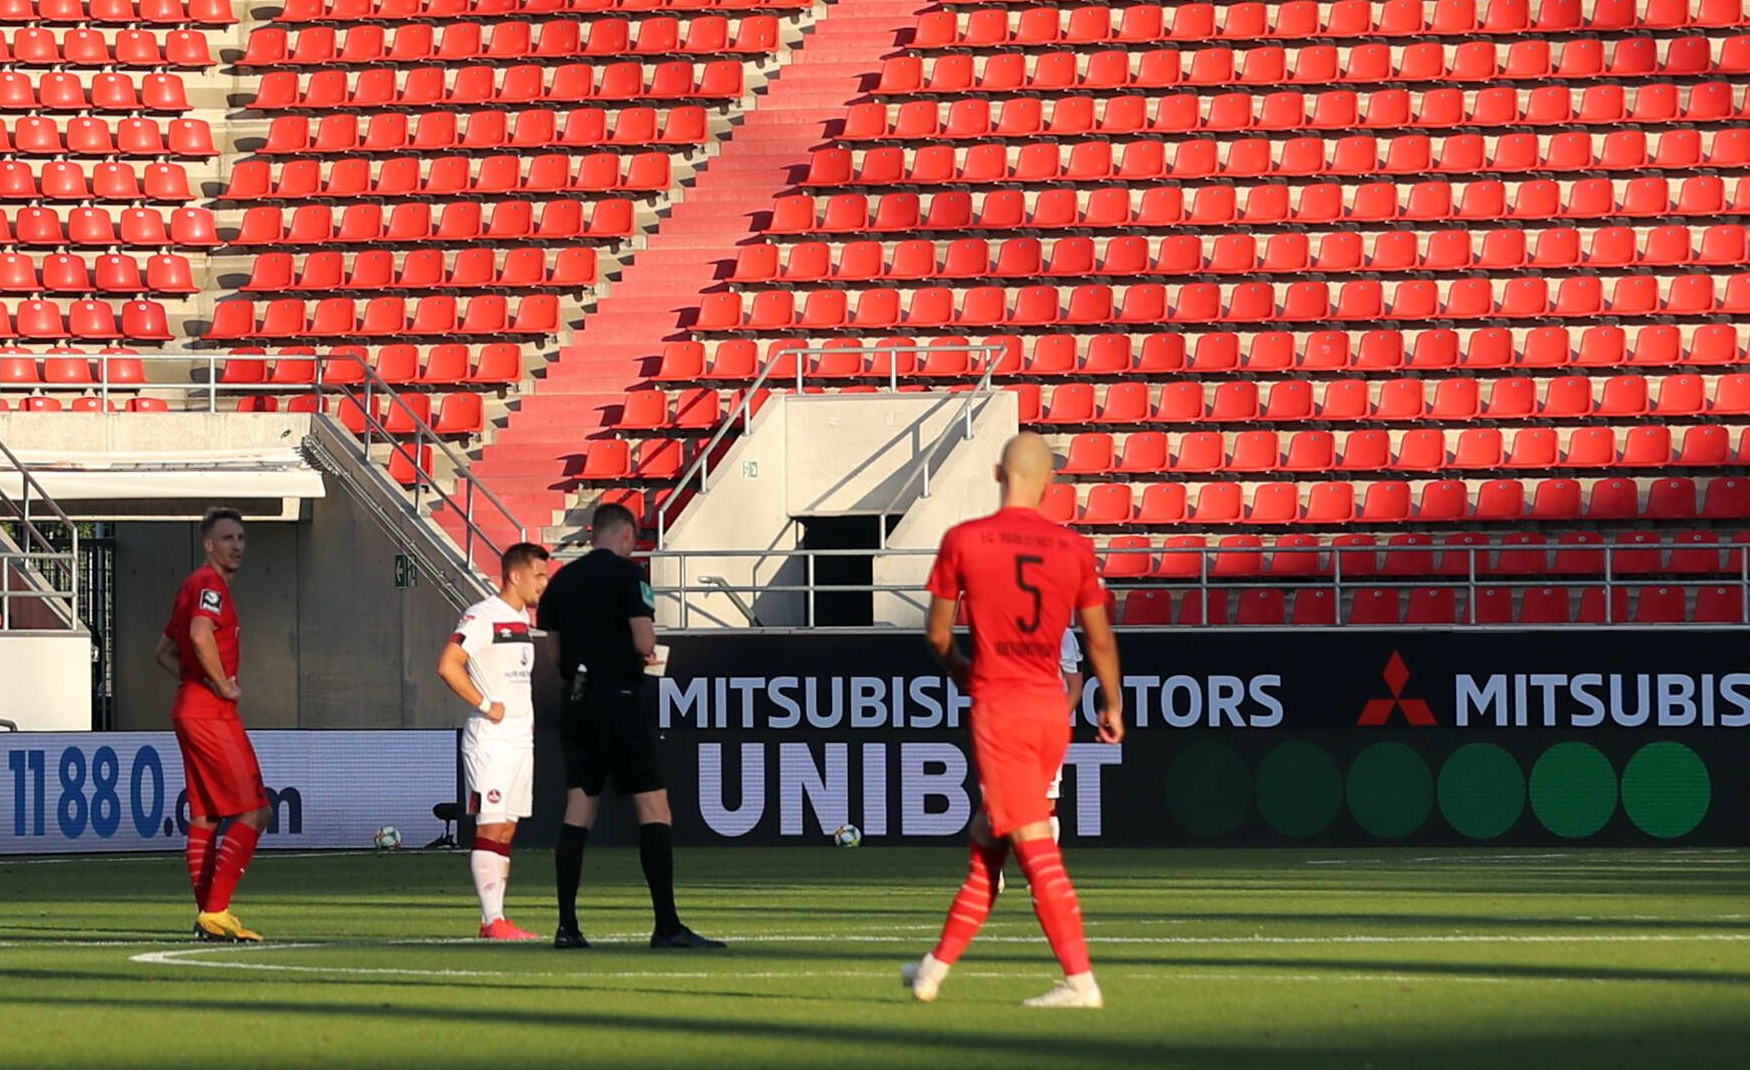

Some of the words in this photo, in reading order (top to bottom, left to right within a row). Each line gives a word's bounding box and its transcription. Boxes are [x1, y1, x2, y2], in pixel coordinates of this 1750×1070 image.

[1015, 554, 1044, 634] 5
[659, 675, 974, 729] MITSUBISH
[1070, 673, 1284, 729] OTORS
[8, 745, 303, 840] 11880.cm
[698, 742, 1123, 838] UNIBT
